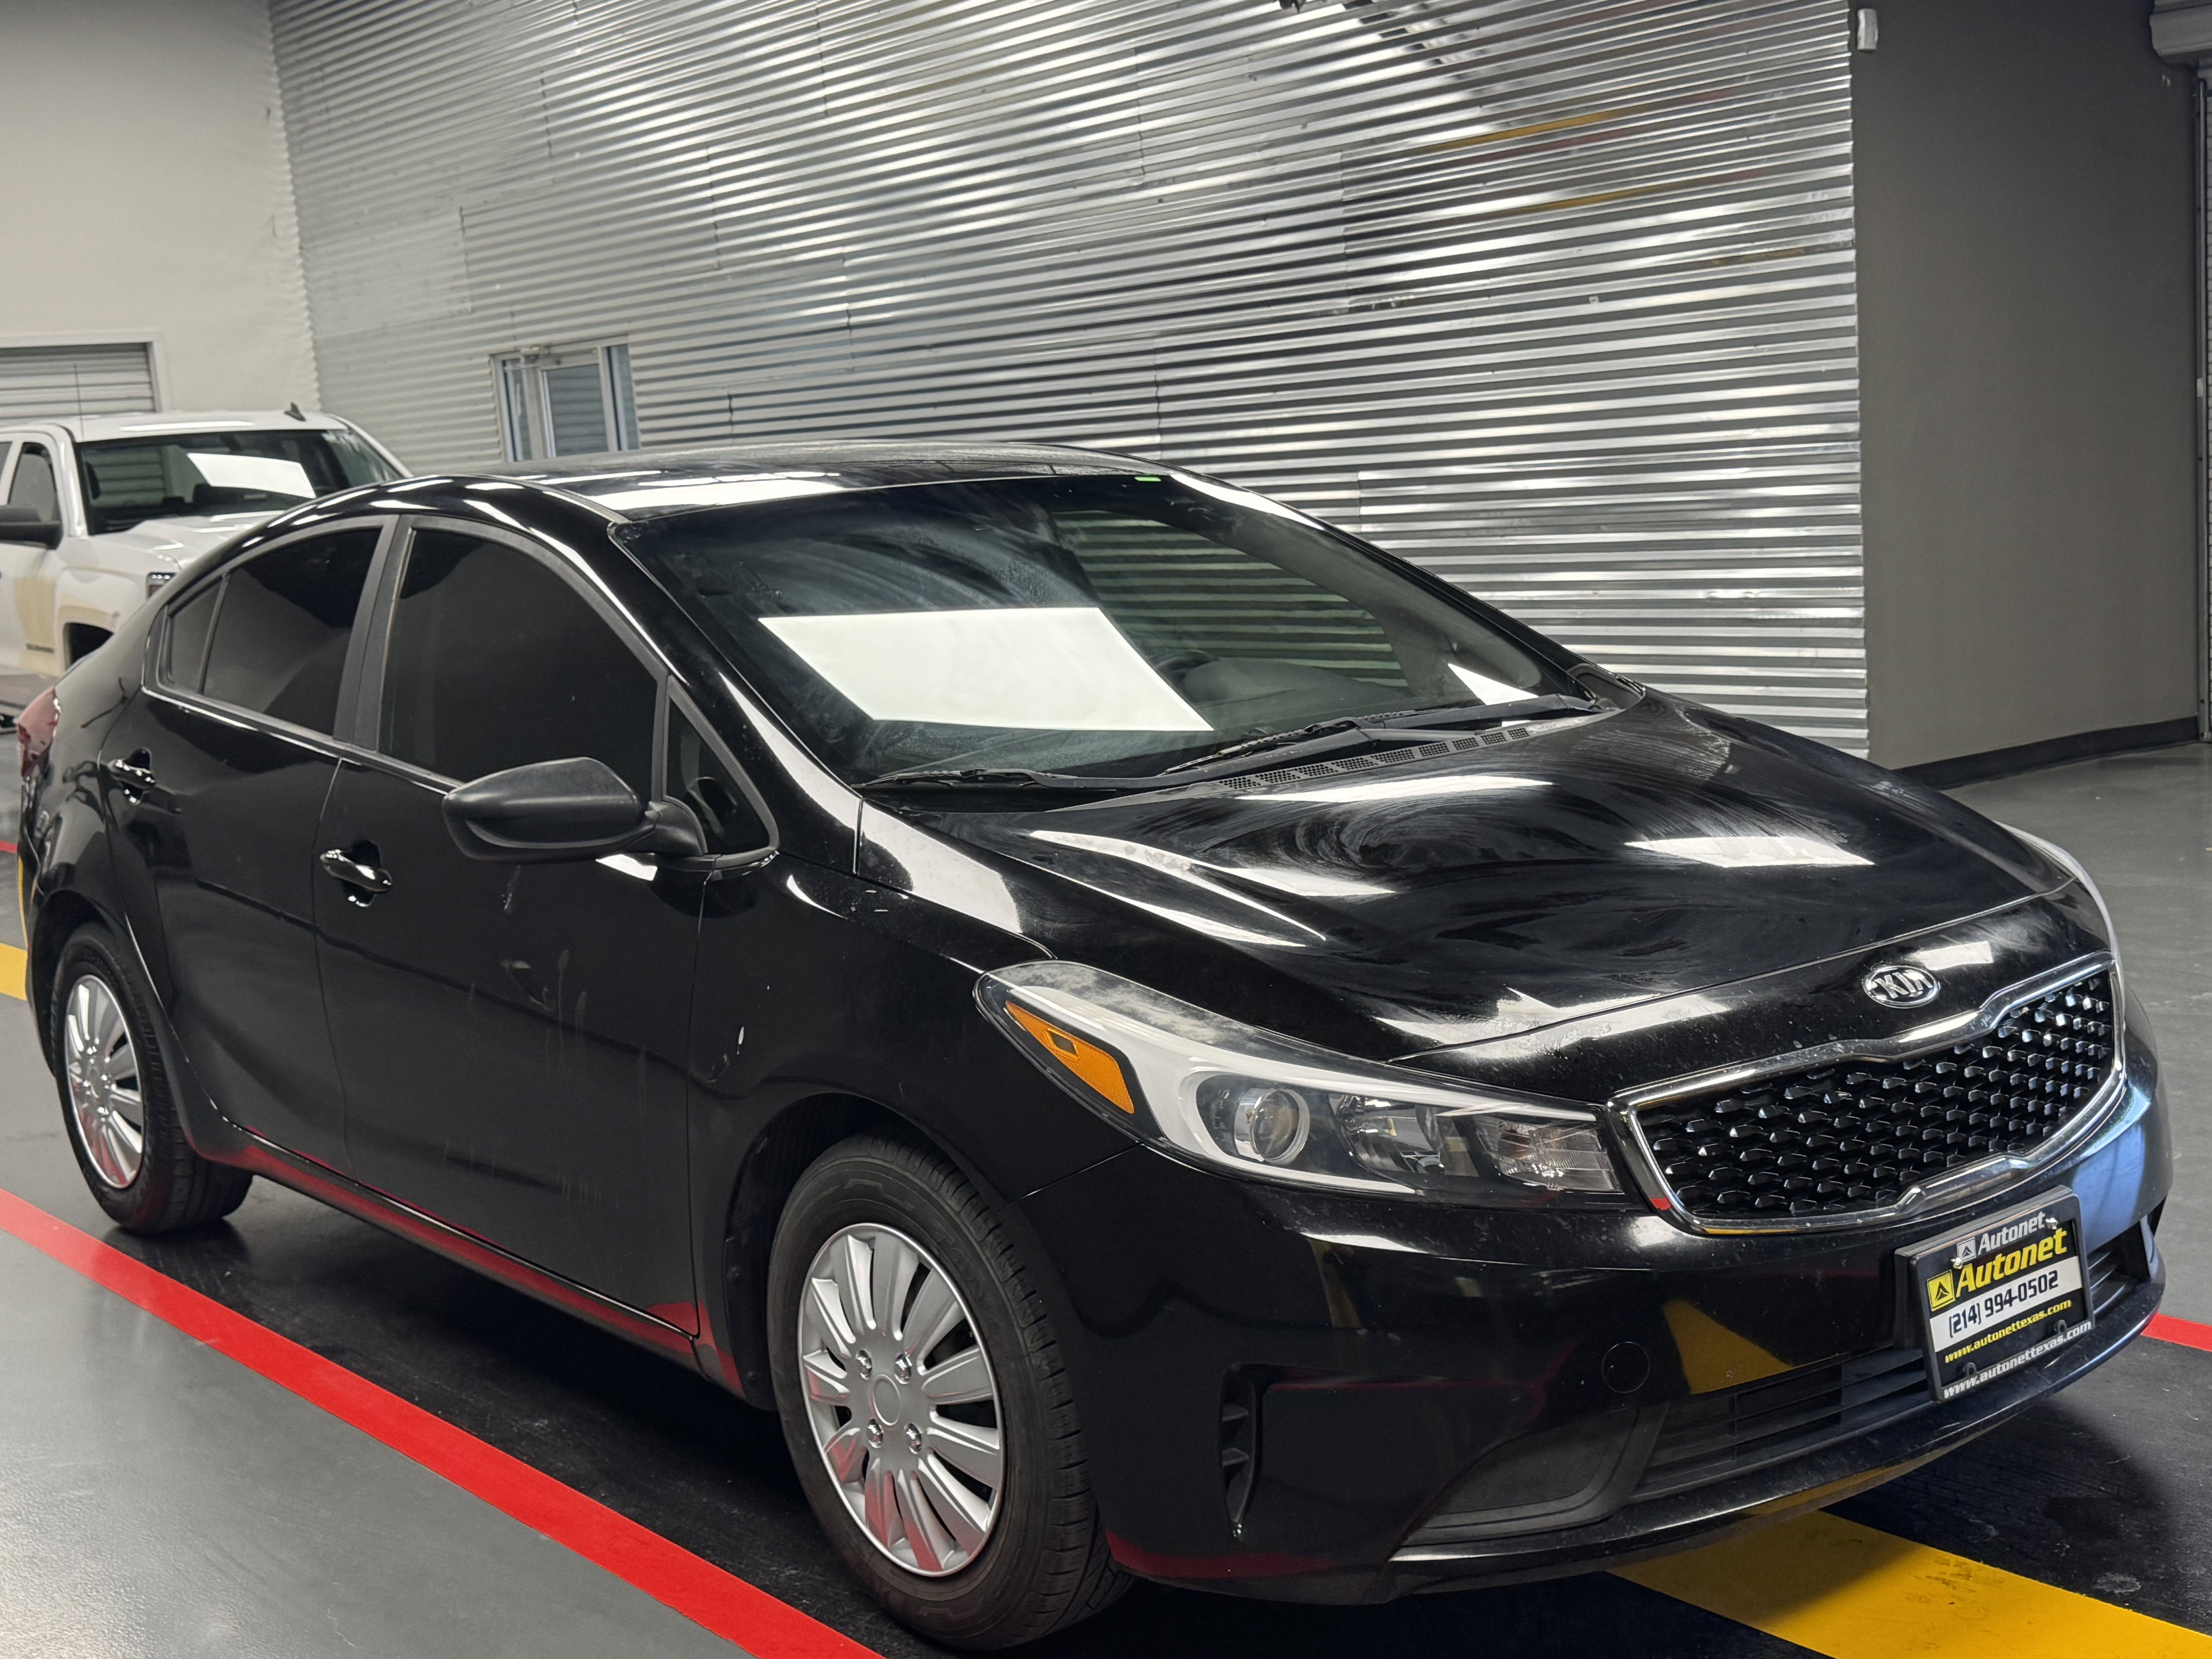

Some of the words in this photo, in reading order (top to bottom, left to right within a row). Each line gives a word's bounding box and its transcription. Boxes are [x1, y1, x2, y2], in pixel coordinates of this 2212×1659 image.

[1874, 969, 1933, 998] KIA
[1956, 1228, 2067, 1298] Autonet
[1978, 1211, 2045, 1255] Autonet
[1944, 1299, 2072, 1363] www.autonettexas.com
[1949, 1303, 1981, 1338] (214)
[1984, 1270, 2059, 1317] 994-0502
[1944, 1321, 2091, 1399] www.autonettexas.com
